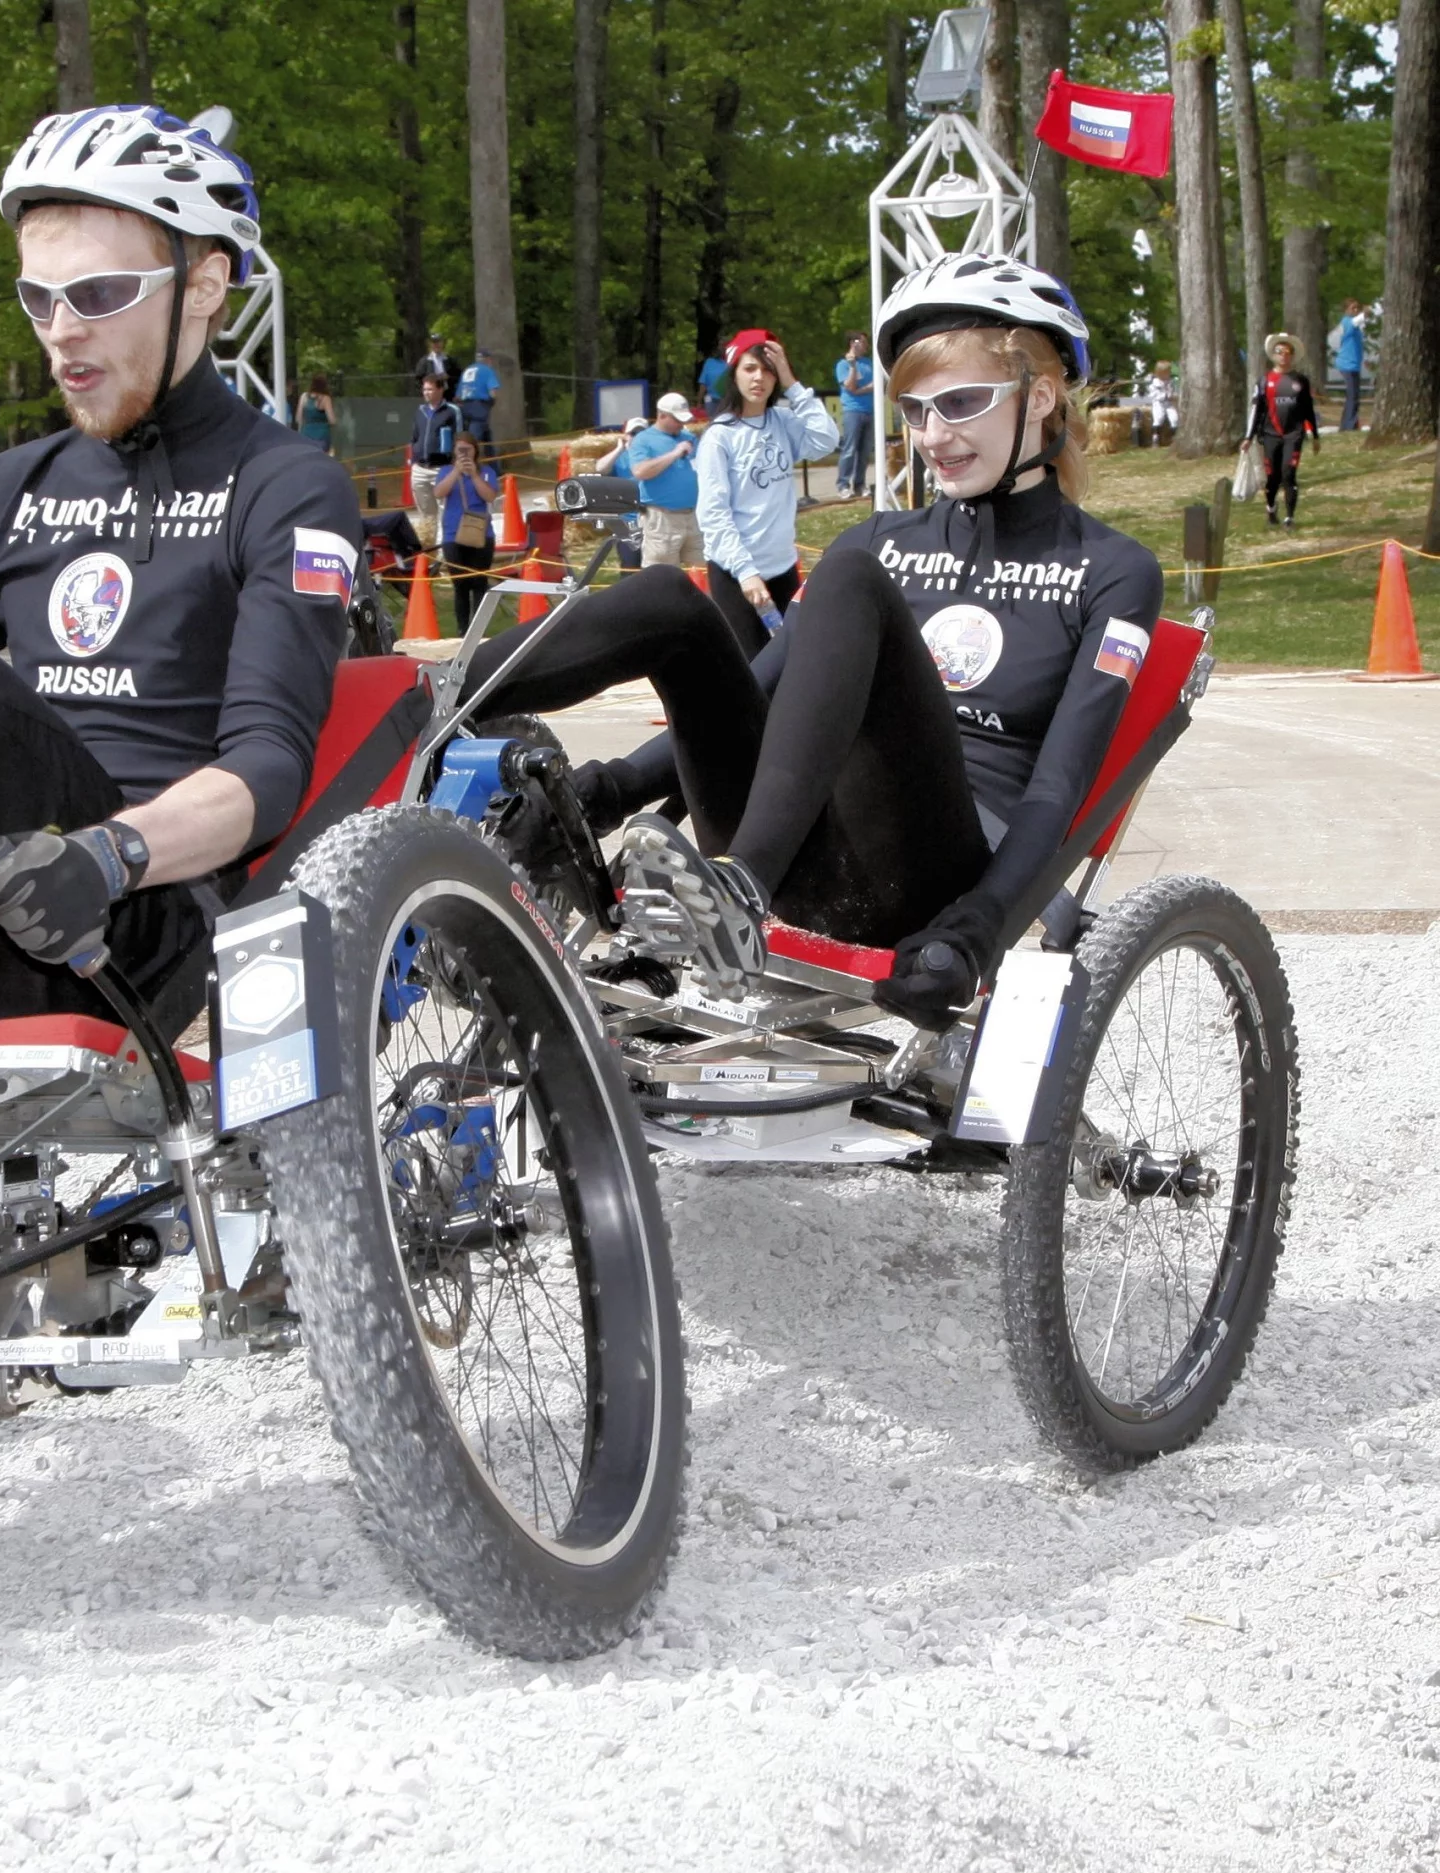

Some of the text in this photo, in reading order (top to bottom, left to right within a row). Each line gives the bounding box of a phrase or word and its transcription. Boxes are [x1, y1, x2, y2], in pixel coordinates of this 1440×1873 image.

[1079, 123, 1114, 138] RUSSIA
[36, 665, 139, 698] RUSSIA
[697, 1000, 745, 1021] MIDLAND
[229, 1060, 301, 1094] SPACE
[715, 1069, 765, 1080] MIDLAND
[228, 1073, 308, 1114] HOTEL
